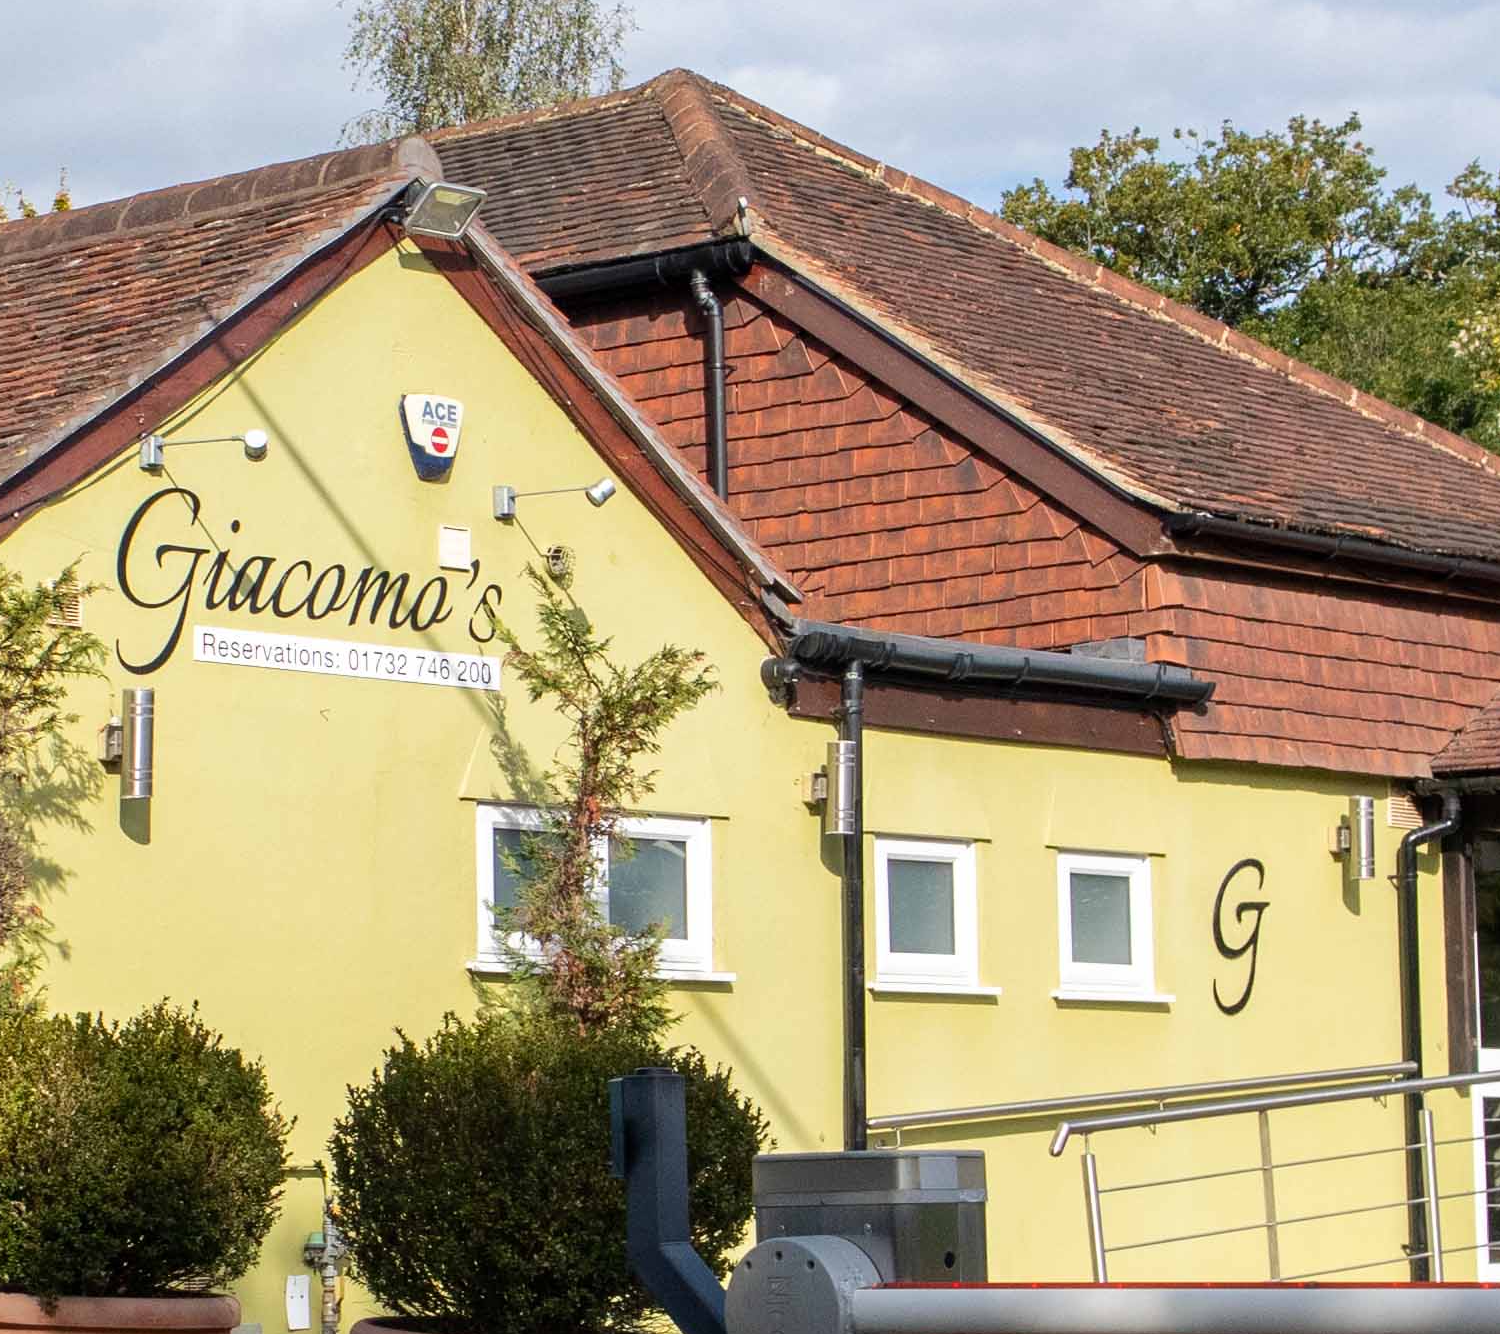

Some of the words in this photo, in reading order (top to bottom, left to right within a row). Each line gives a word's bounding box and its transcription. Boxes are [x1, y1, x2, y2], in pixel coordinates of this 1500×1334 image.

[422, 401, 457, 422] ACE
[115, 487, 503, 675] Giacomo's
[202, 632, 340, 669] Reservations:
[349, 648, 408, 676] 01732
[416, 655, 451, 680] 746
[457, 660, 492, 685] 200
[1211, 857, 1271, 1016] G
